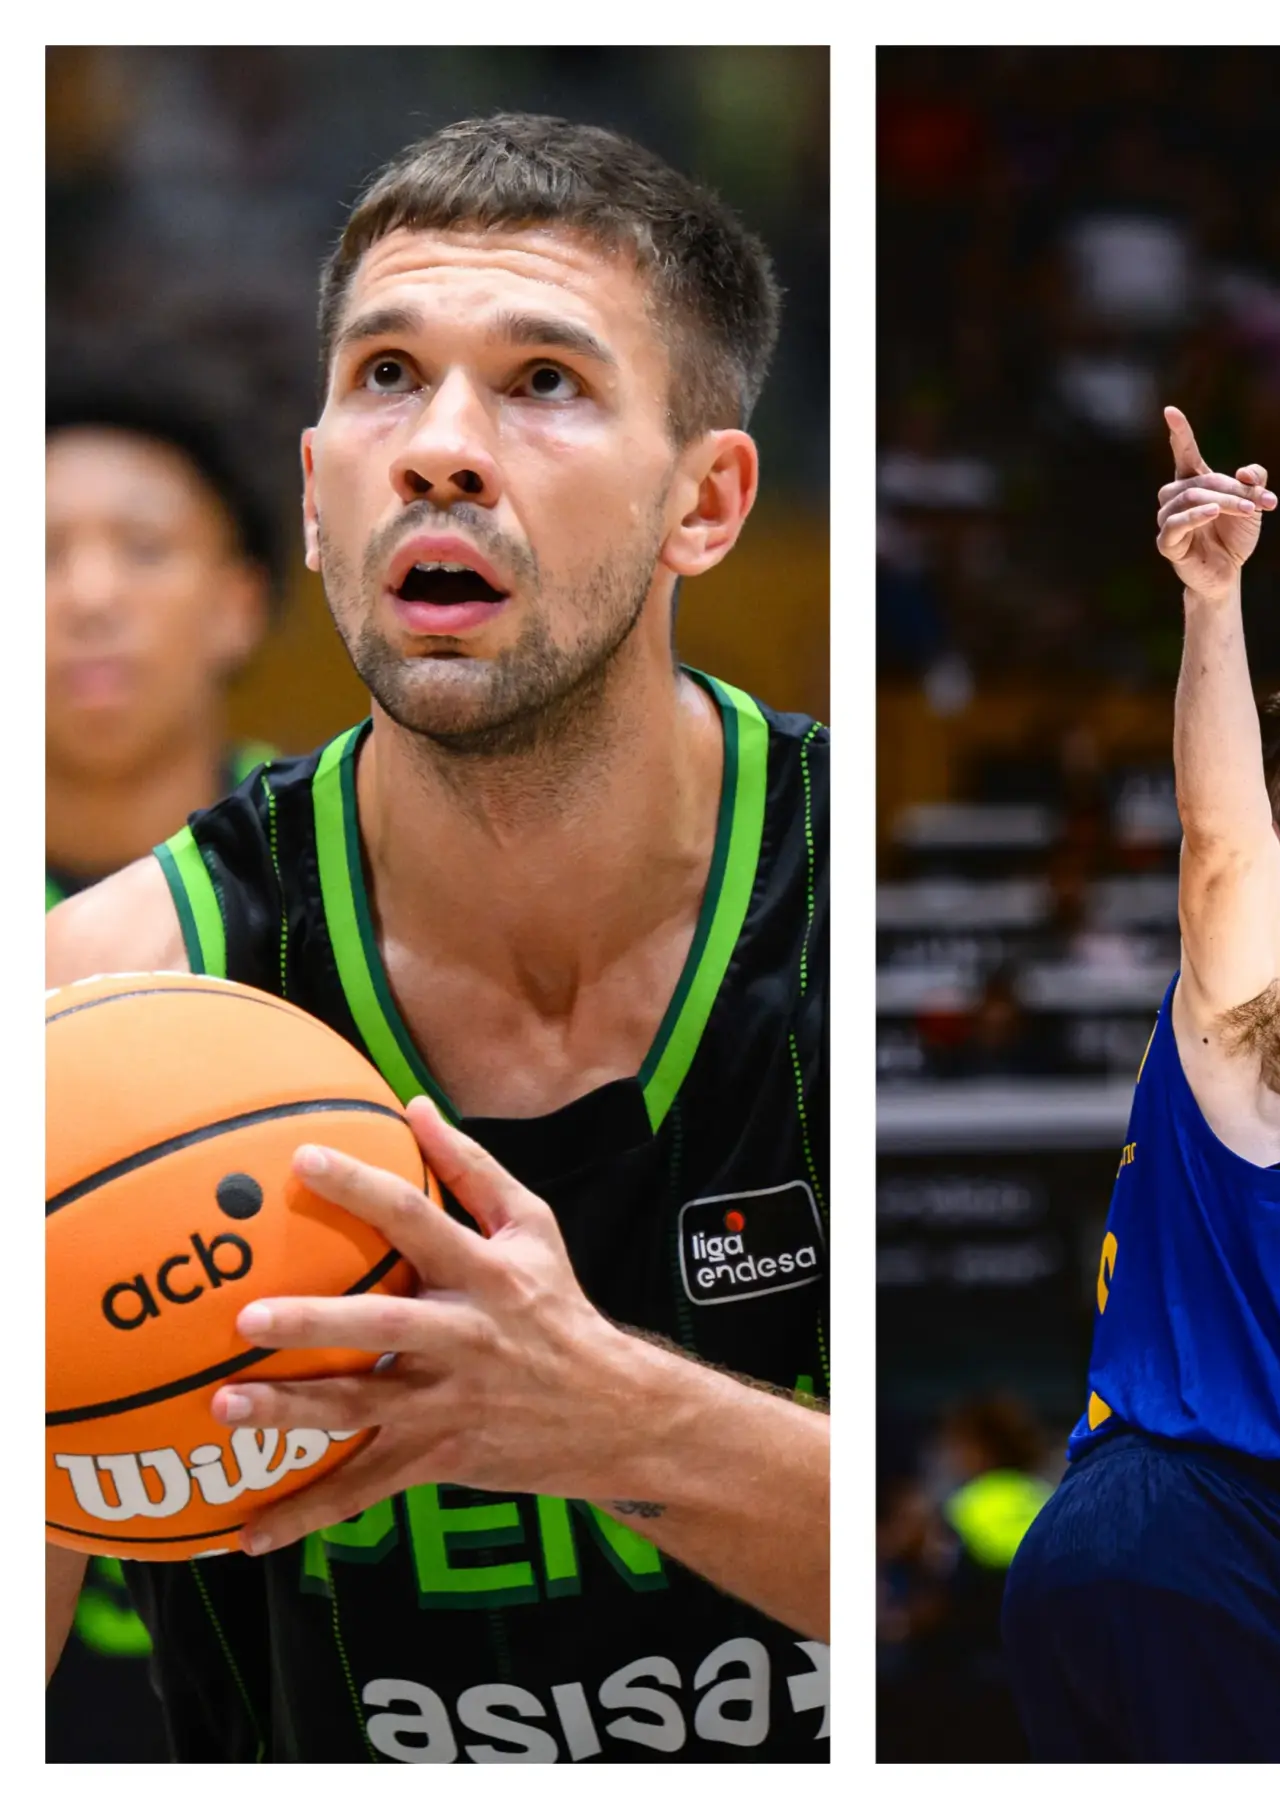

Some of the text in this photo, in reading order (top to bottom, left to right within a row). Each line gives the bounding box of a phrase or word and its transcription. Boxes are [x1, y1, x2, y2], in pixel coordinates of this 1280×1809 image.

[101, 1232, 253, 1331] acb
[692, 1232, 745, 1262] liga
[697, 1246, 817, 1288] endesa
[54, 1427, 362, 1522] Wils
[362, 1637, 770, 1764] asisa
